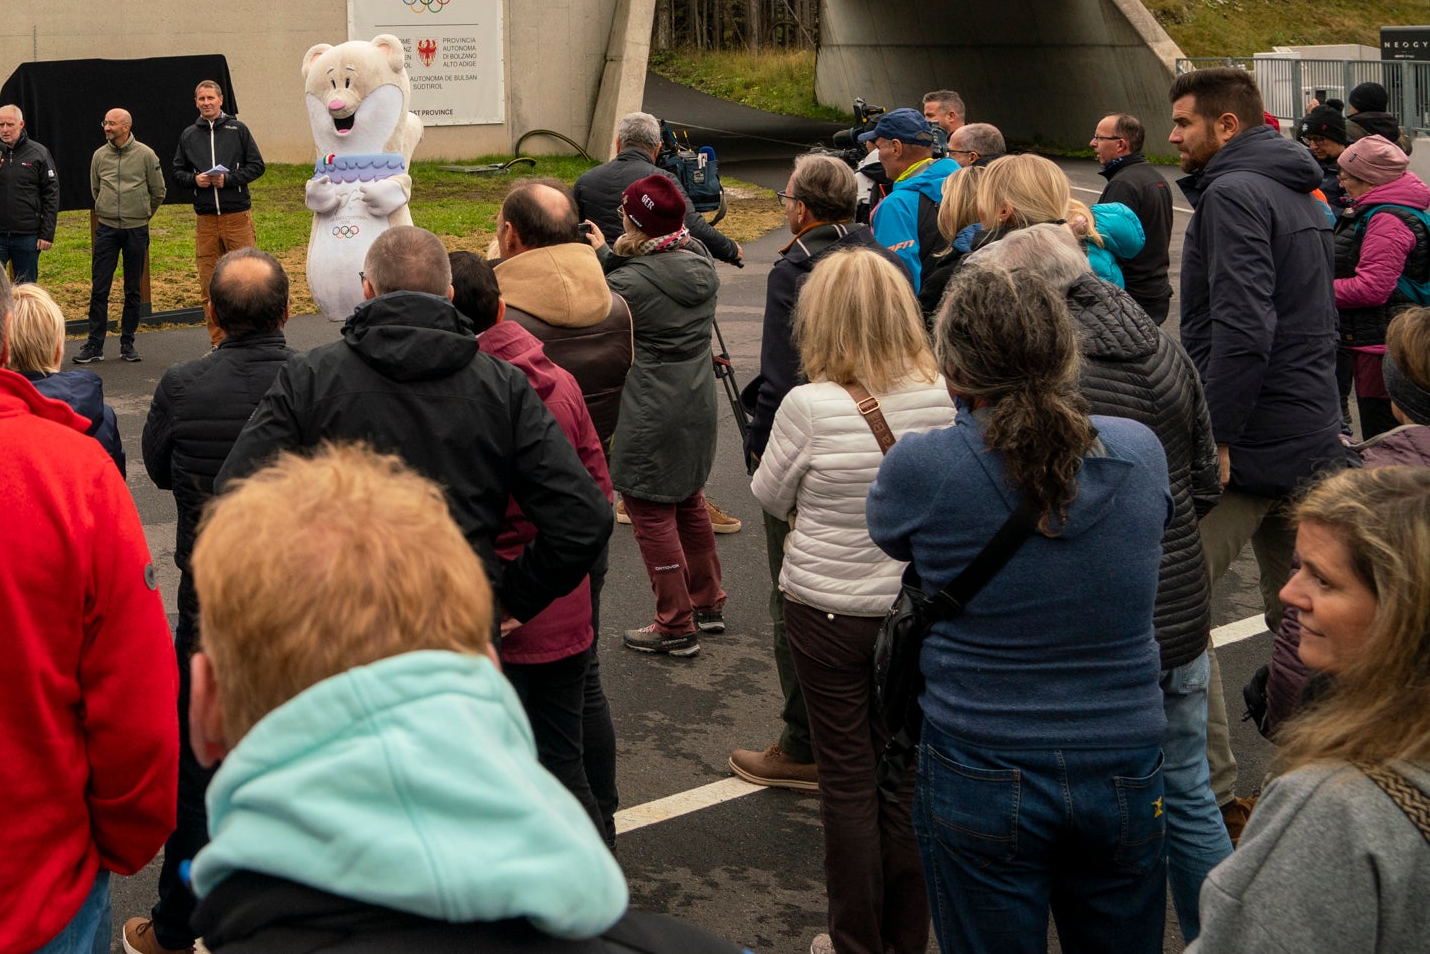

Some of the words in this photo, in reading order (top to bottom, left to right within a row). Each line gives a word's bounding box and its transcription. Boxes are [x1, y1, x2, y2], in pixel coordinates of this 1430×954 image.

[450, 52, 477, 60] BOLZANO
[413, 82, 443, 90] SÜDTIROL
[641, 193, 655, 211] GER
